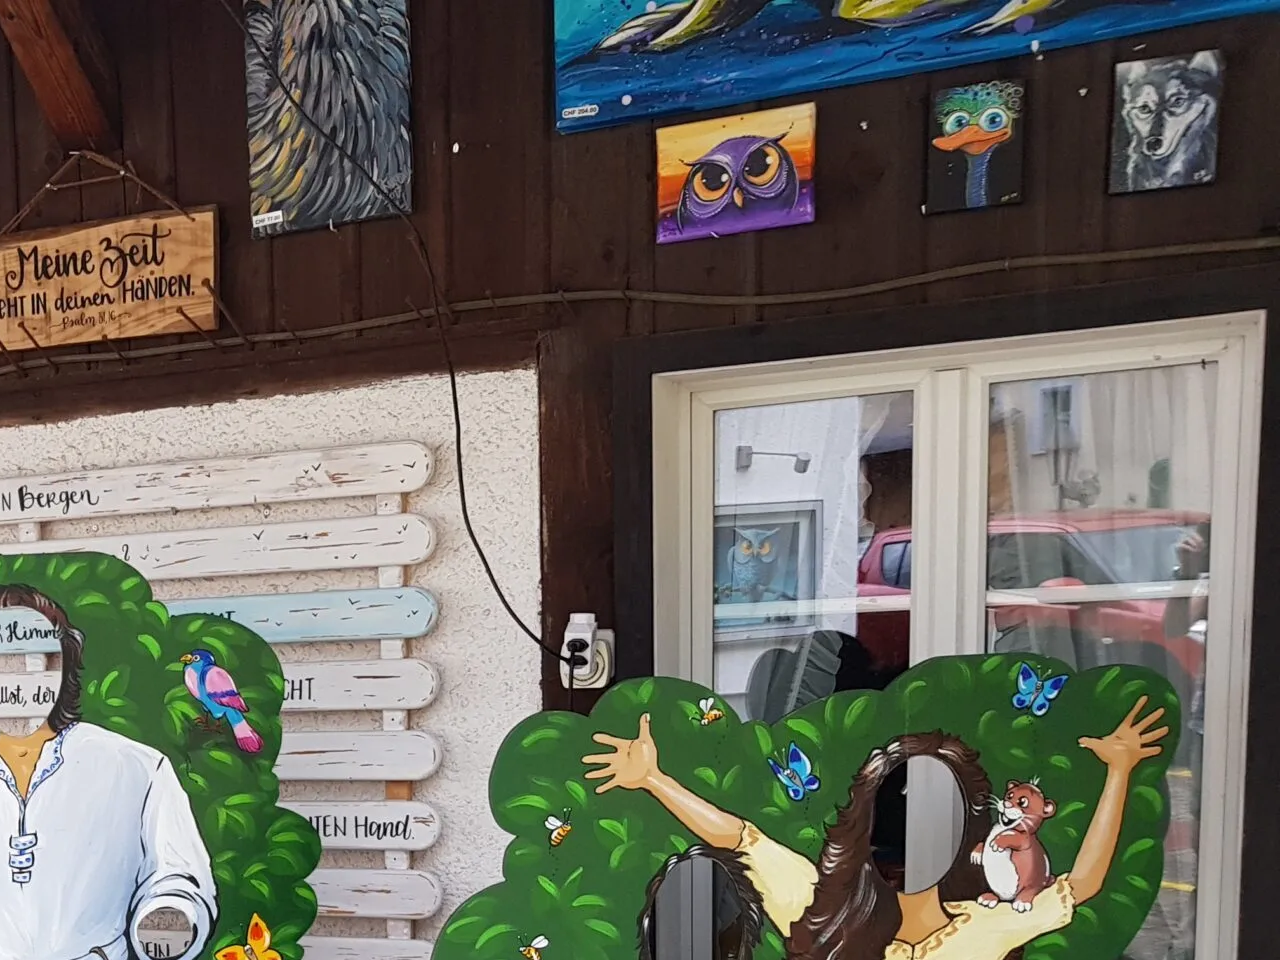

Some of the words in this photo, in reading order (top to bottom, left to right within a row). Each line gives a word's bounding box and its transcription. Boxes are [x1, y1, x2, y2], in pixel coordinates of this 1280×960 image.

[5, 245, 95, 290] Meine
[99, 223, 171, 288] Zeit
[31, 292, 47, 316] IN
[54, 286, 115, 313] deinen
[59, 311, 96, 330] Psalm
[32, 685, 57, 706] der
[354, 814, 415, 840] Hand.
